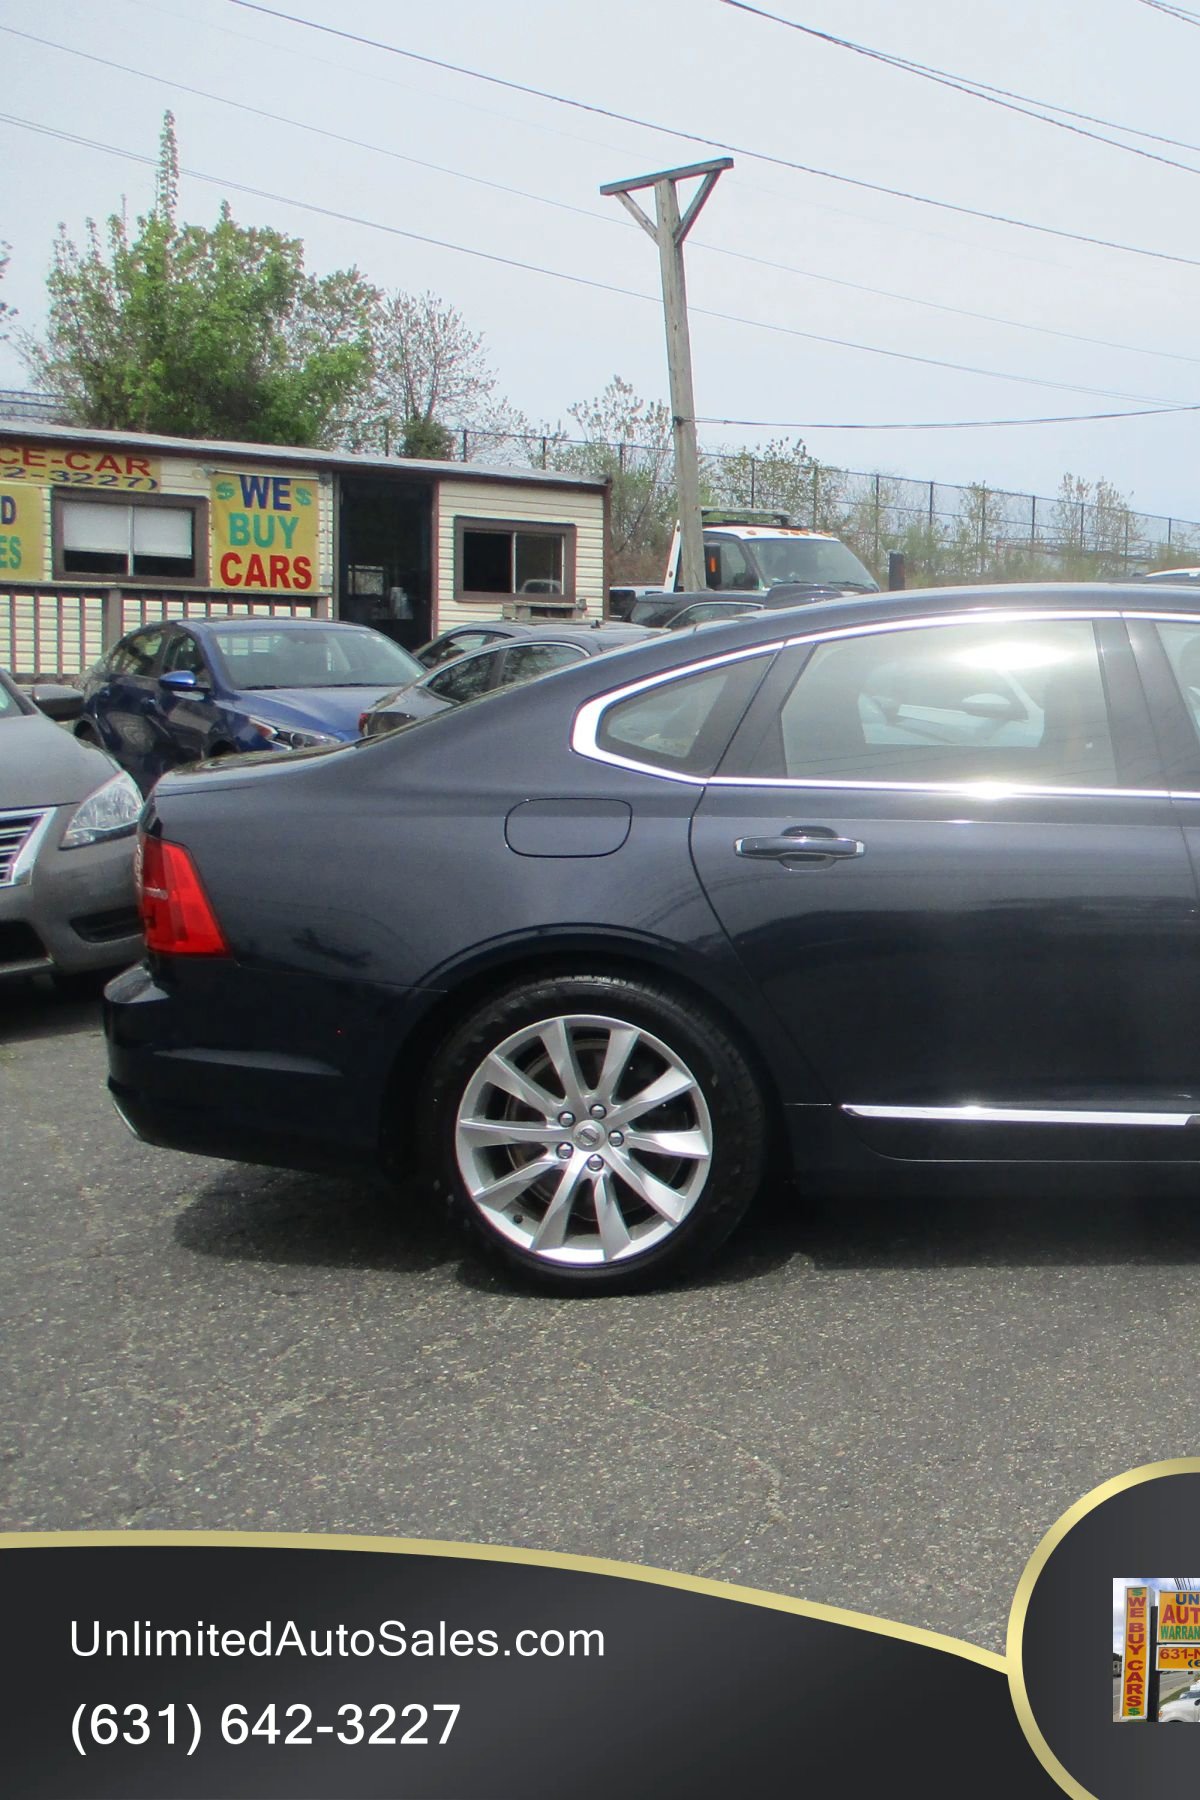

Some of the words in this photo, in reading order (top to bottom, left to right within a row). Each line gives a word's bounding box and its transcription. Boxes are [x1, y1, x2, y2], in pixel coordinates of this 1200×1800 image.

[240, 475, 292, 511] WE
[228, 512, 300, 549] BUY
[220, 552, 313, 590] CARS
